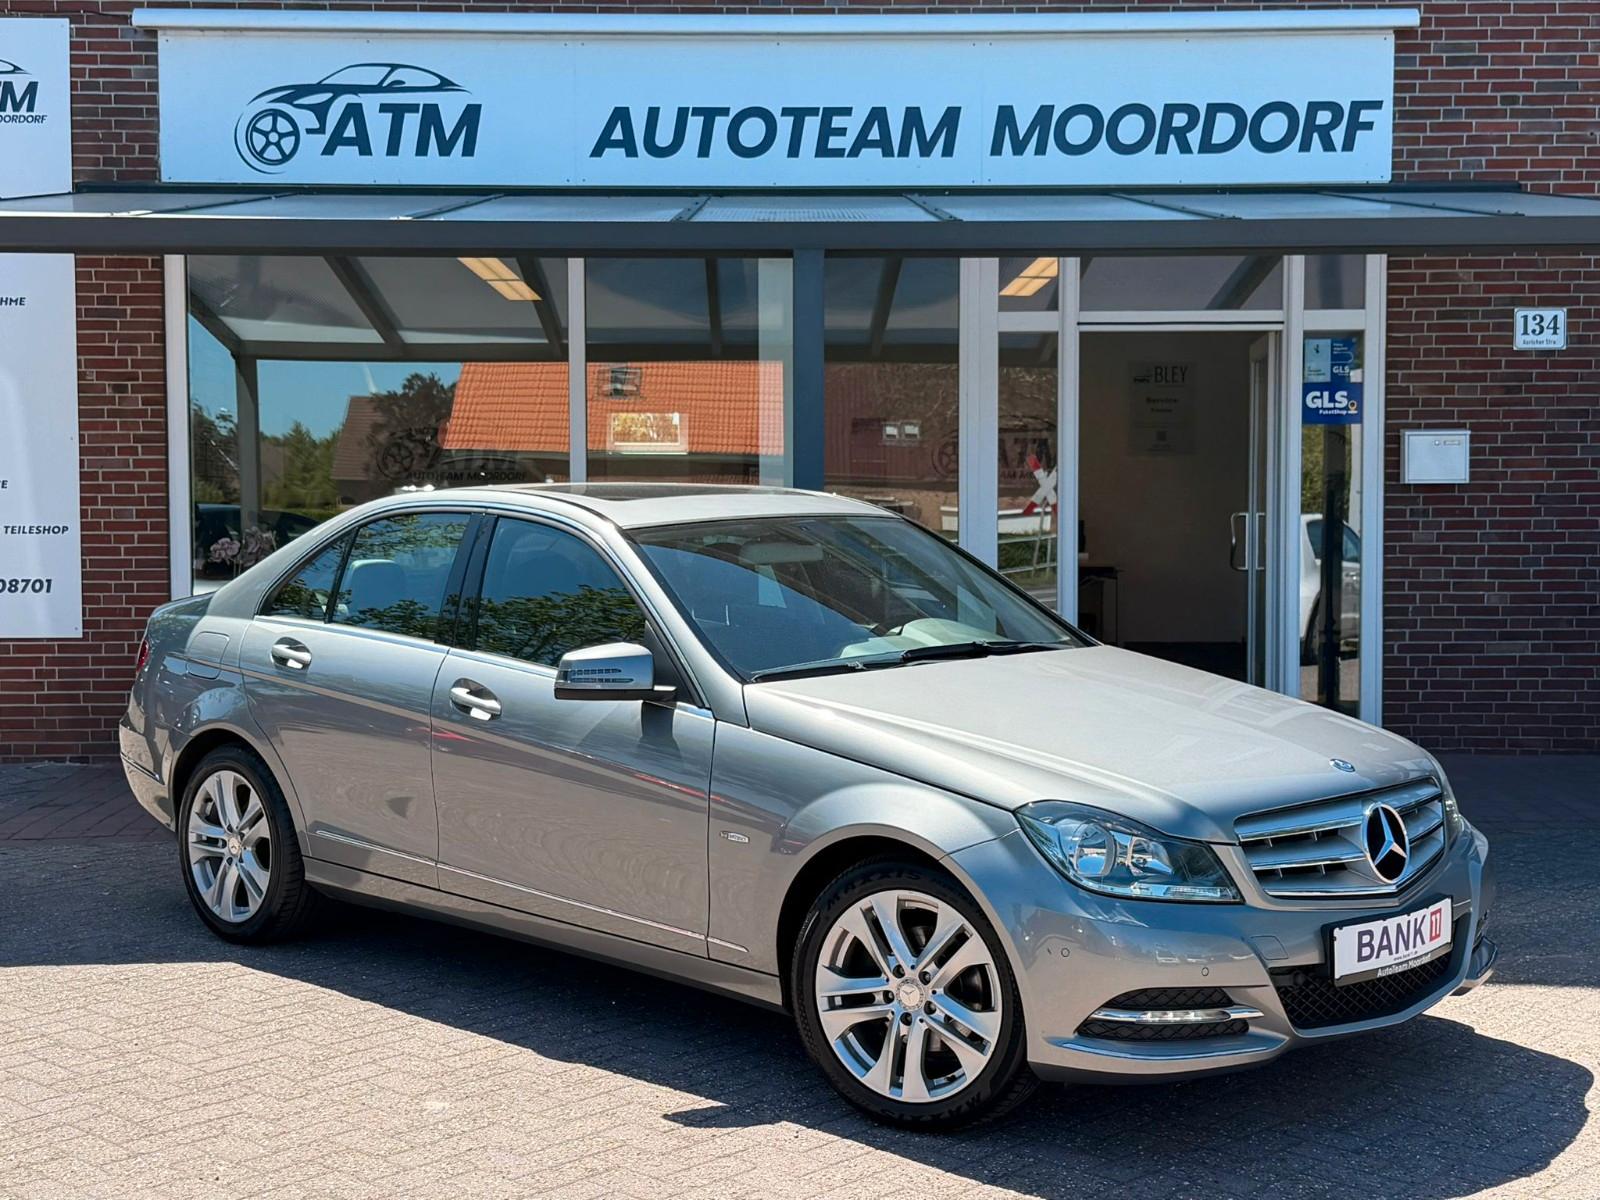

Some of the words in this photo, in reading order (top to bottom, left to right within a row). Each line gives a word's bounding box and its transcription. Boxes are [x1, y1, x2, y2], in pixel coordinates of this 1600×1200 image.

[321, 102, 482, 158] ATM
[589, 106, 962, 159] AUTOTEAM
[990, 99, 1383, 157] MOORDORF
[1520, 313, 1560, 336] 134
[1154, 366, 1188, 383] BLEY
[1332, 365, 1350, 374] GLS
[1305, 390, 1349, 409] GLS
[3, 525, 69, 535] TEILESHOP
[1357, 914, 1427, 963] BANK
[1377, 964, 1408, 978] AutoTeam
